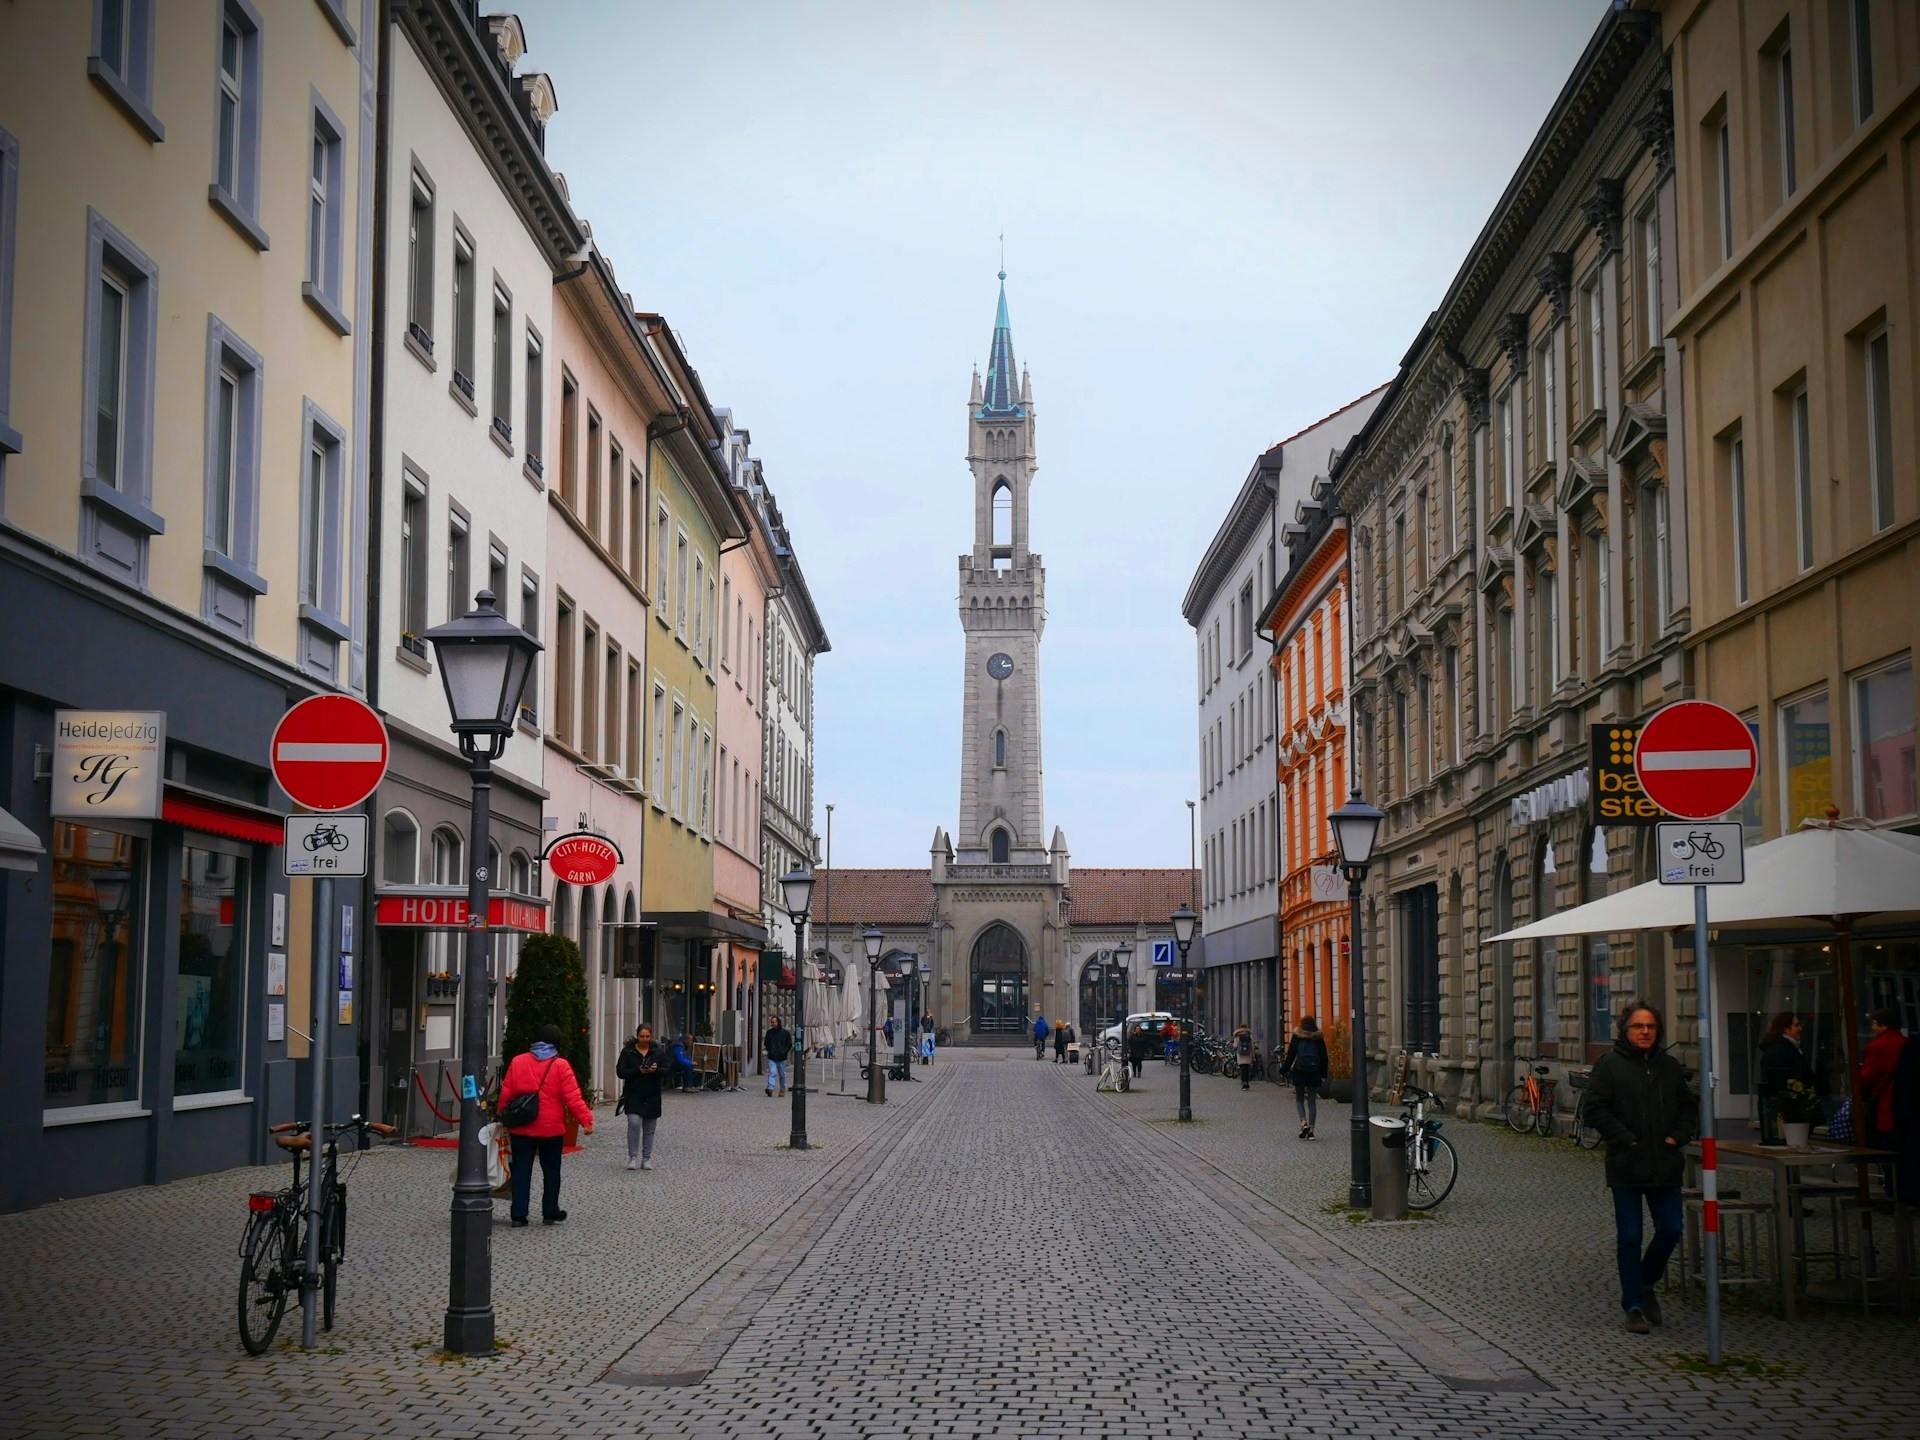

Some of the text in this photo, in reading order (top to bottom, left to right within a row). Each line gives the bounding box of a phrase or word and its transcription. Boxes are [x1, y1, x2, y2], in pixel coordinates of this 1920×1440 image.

[1598, 768, 1643, 793] ba
[555, 841, 613, 861] CITY-HOTEL
[313, 855, 338, 868] frei
[1688, 863, 1716, 877] frei
[567, 869, 597, 883] GARNI
[402, 898, 466, 924] HOTE
[96, 1063, 130, 1089] Friseur
